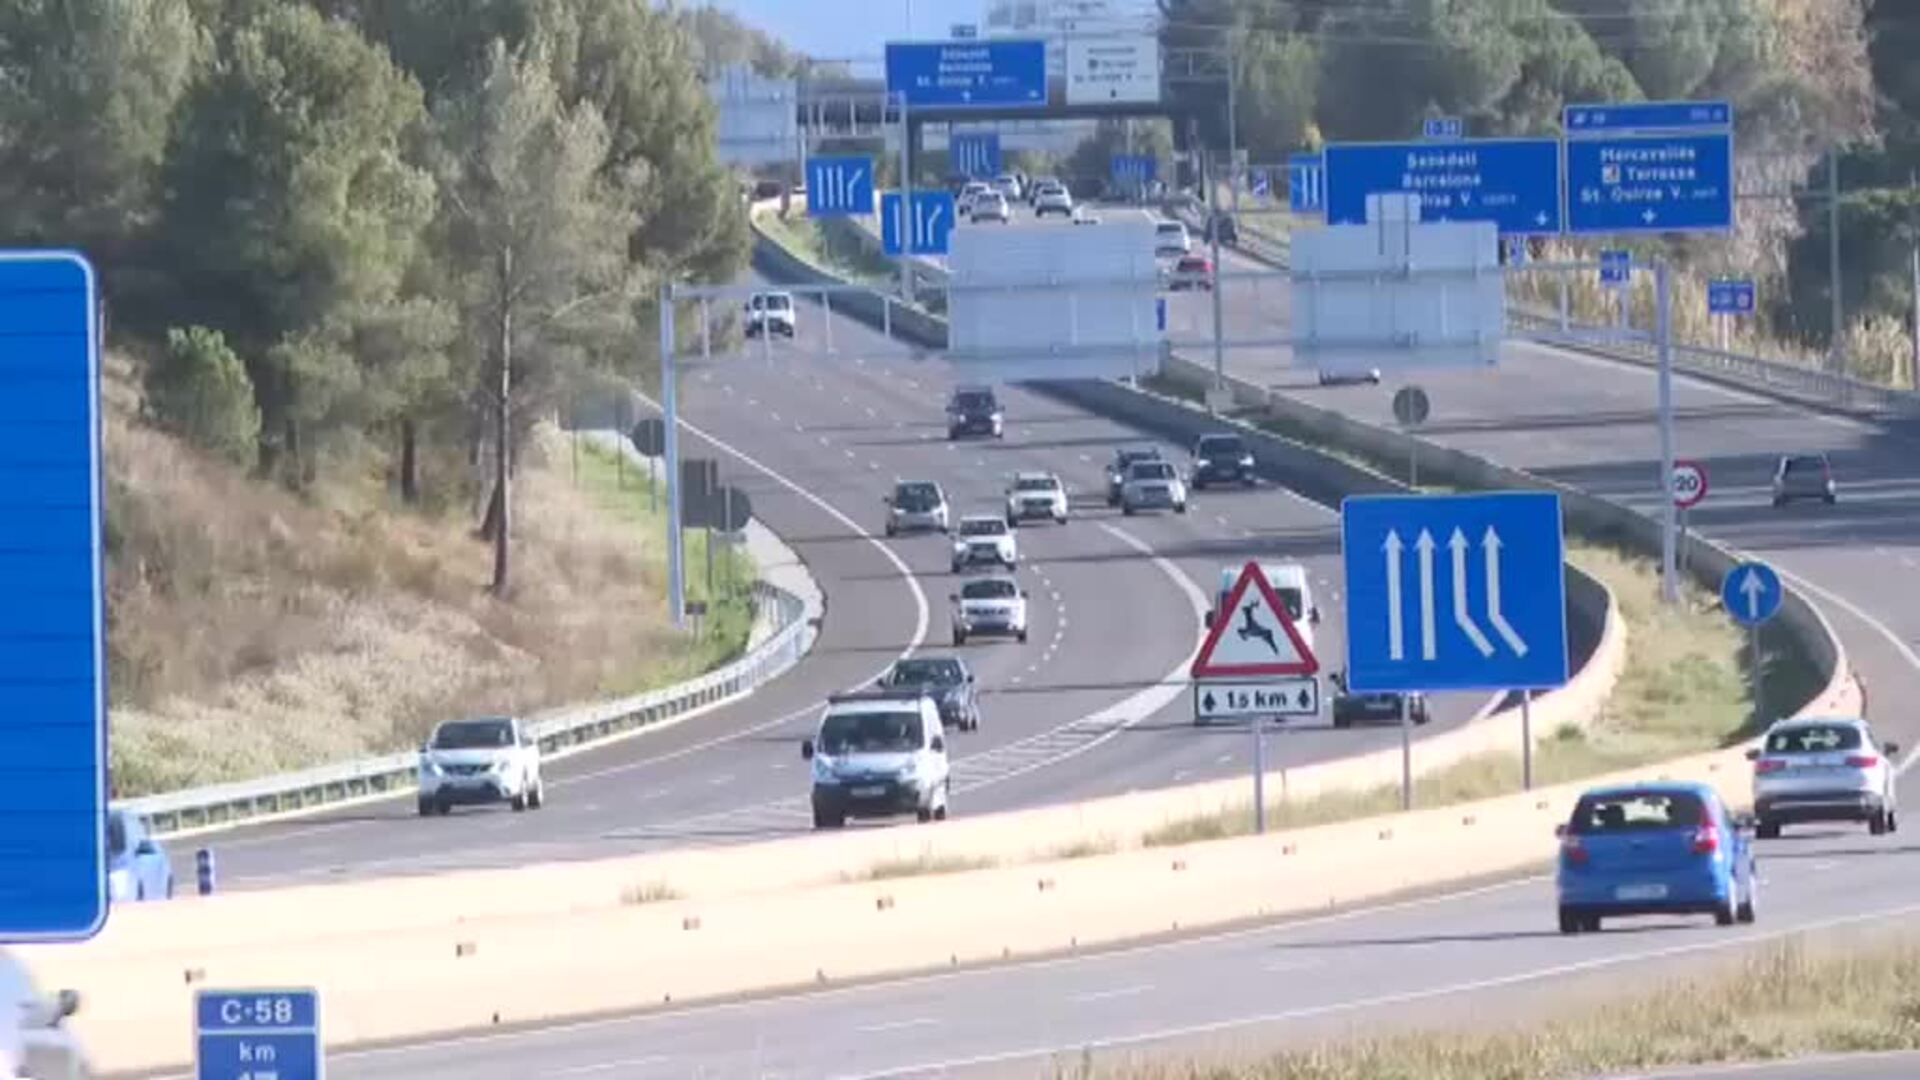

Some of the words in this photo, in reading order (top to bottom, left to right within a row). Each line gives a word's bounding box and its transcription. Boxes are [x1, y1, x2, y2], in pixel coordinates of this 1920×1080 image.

[1676, 474, 1699, 492] 20
[1254, 689, 1288, 707] km
[239, 1041, 277, 1063] km
